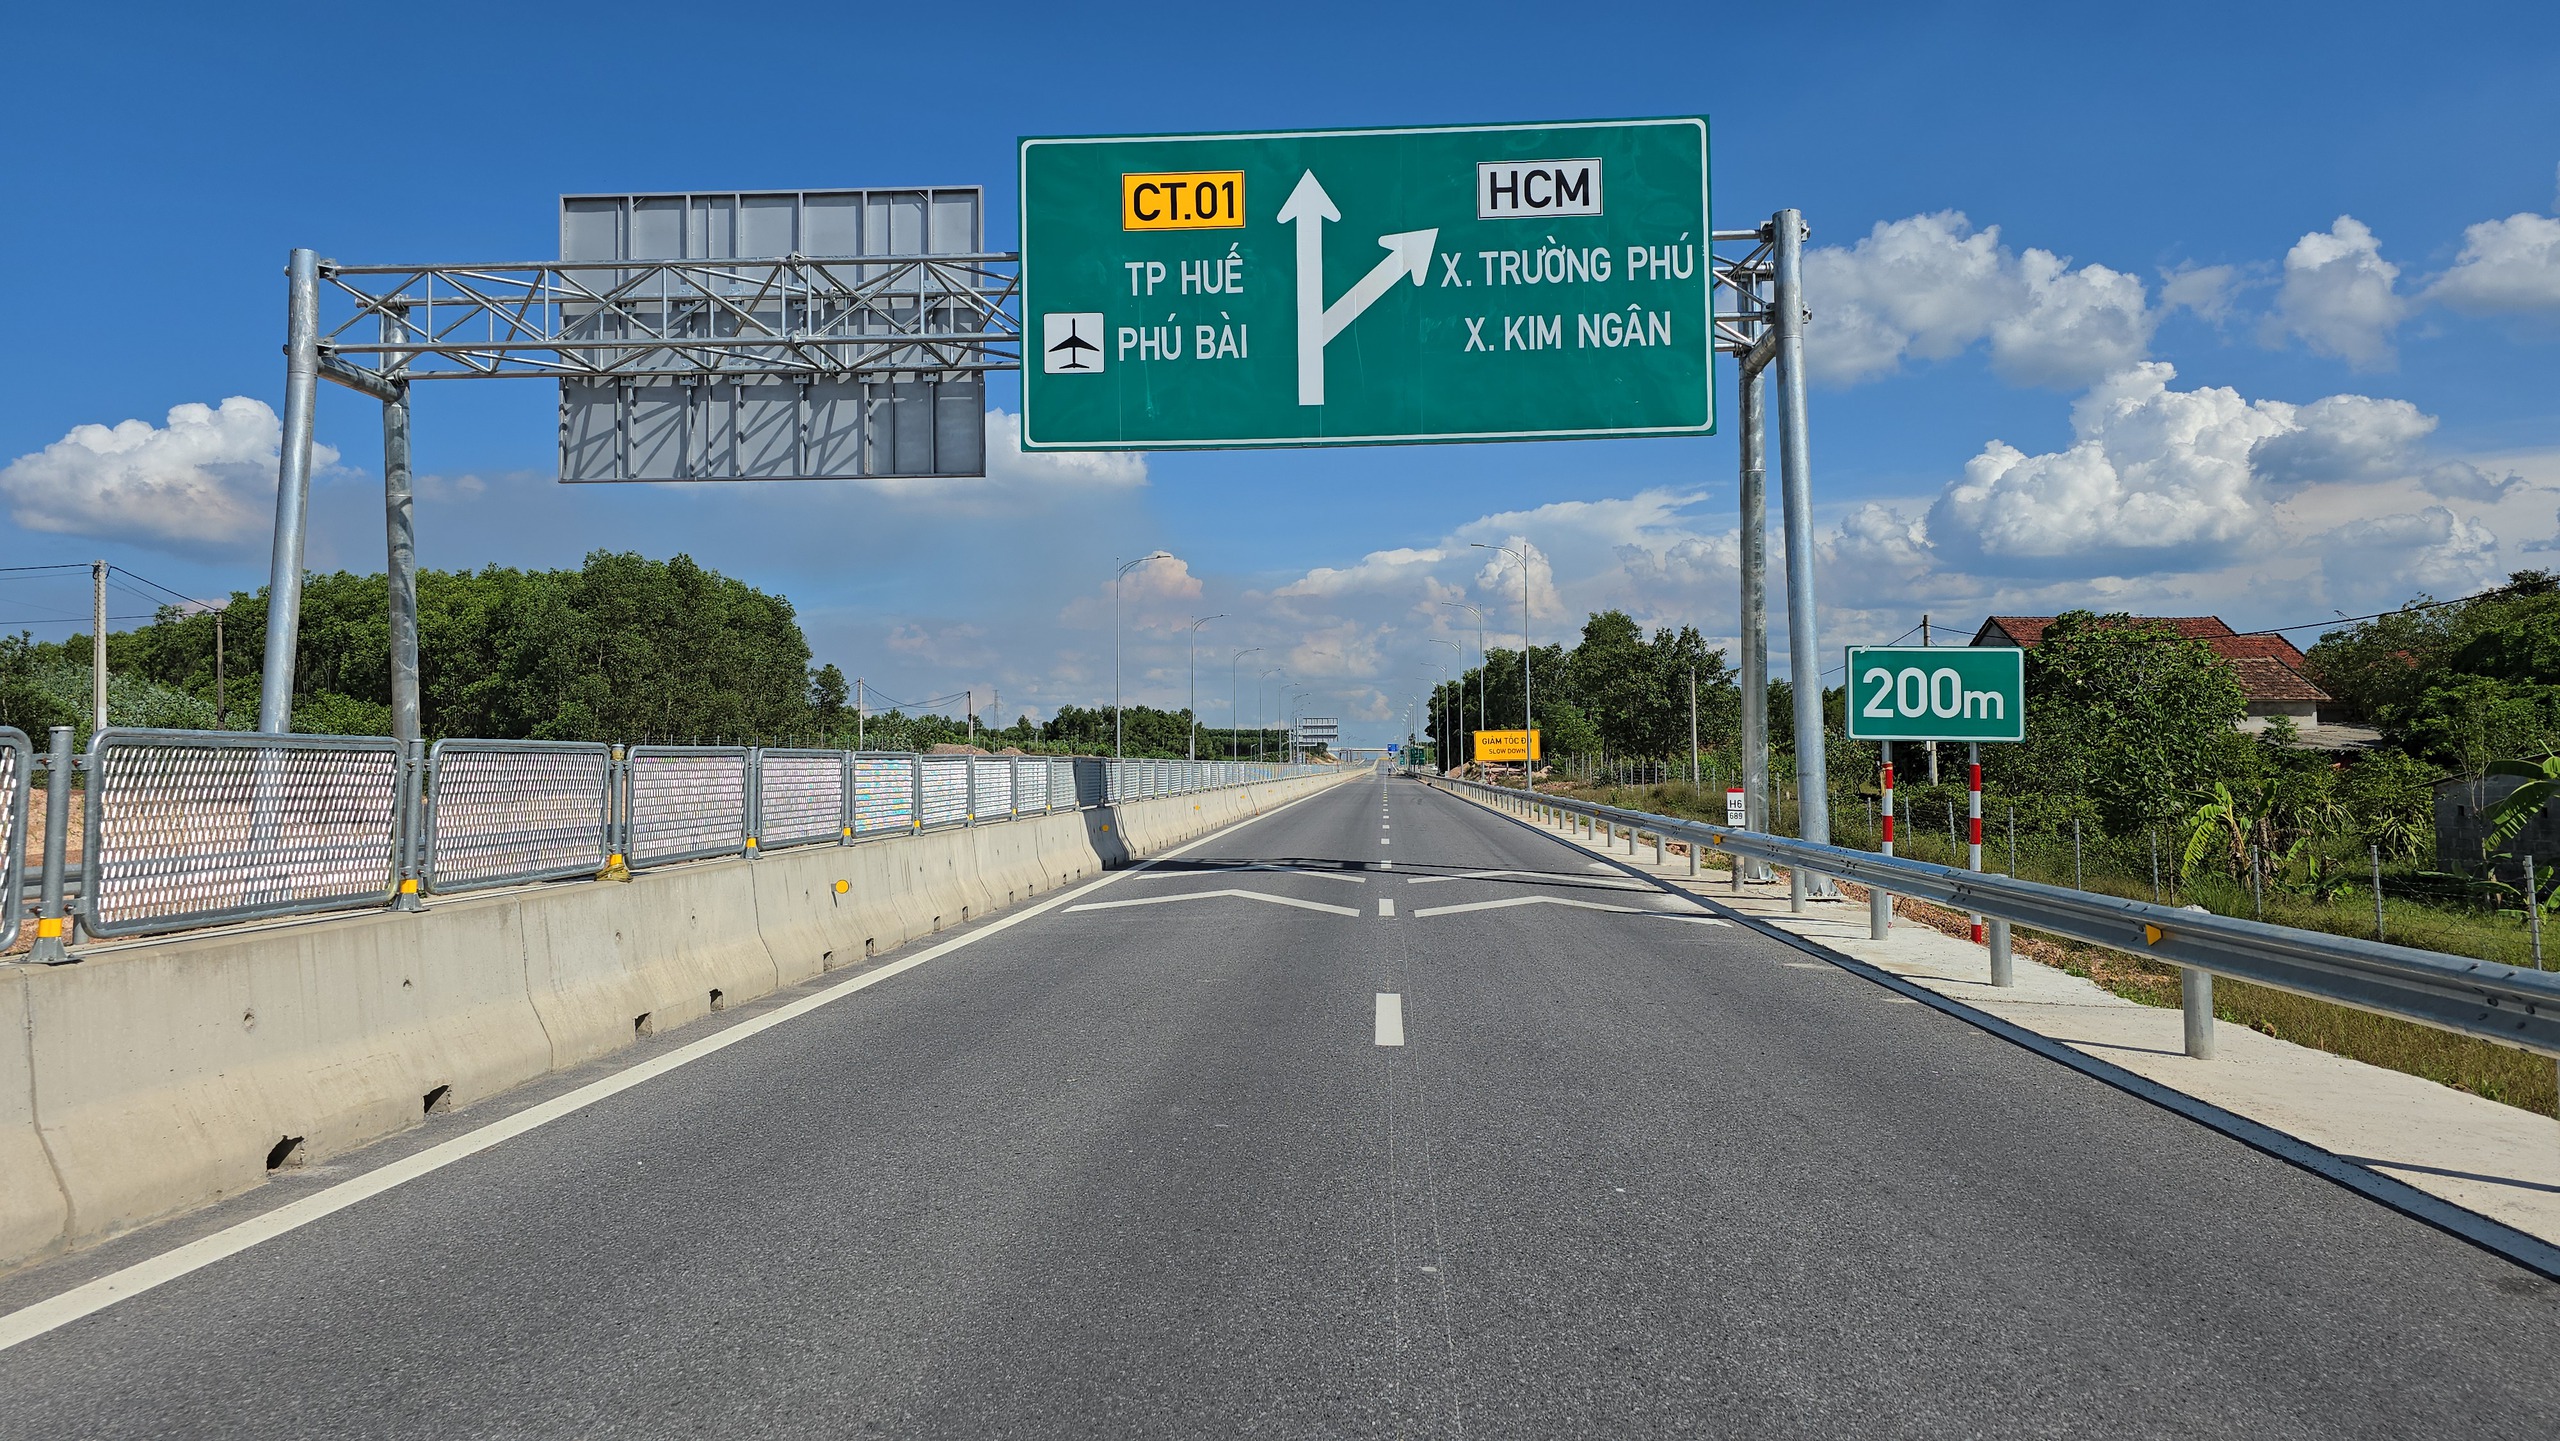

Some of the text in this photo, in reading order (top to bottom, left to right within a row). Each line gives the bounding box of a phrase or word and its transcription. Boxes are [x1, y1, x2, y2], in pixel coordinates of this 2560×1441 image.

[1133, 181, 1235, 221] CT.01
[1490, 168, 1590, 209] HCM
[1124, 242, 1244, 296] TP HUẾ
[1440, 231, 1694, 288] X. TRƯỜNG PHÚ
[1118, 311, 1248, 362] PHÚ BÀI
[1464, 303, 1671, 352] X. KIM NGÂN
[1862, 667, 2004, 720] 200m
[1729, 799, 1742, 808] H6
